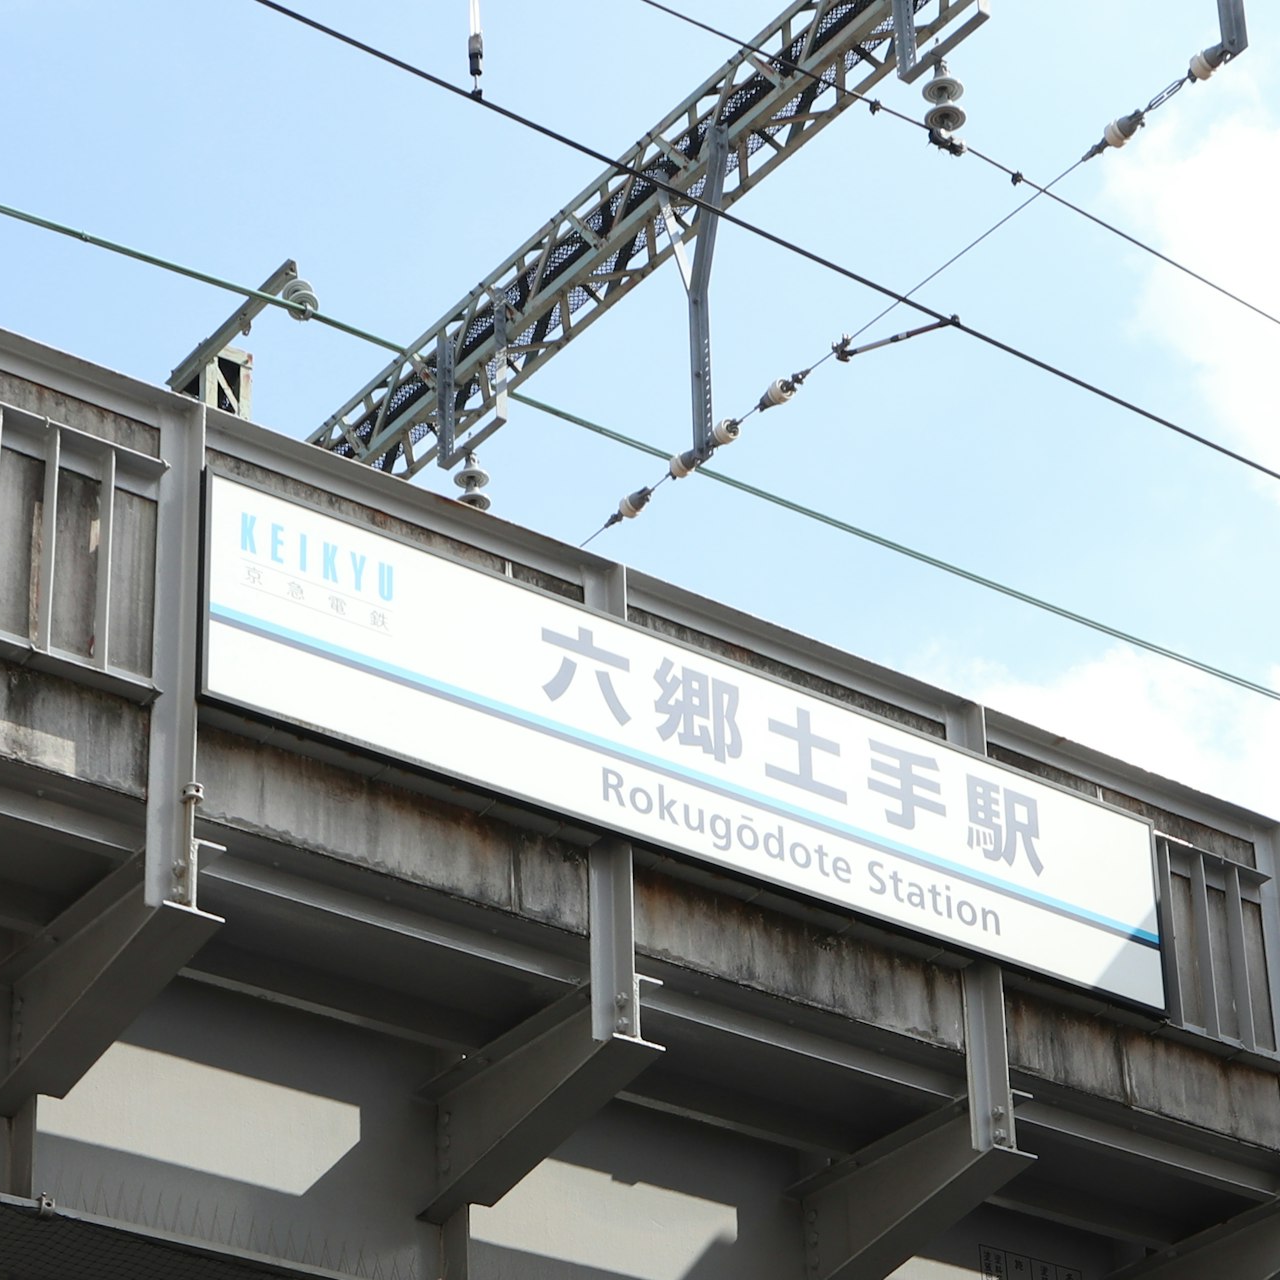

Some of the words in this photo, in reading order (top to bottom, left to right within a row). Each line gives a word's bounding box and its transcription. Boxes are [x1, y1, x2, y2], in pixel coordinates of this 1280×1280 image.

[240, 511, 394, 603] KEIKYU
[245, 566, 390, 630] 京急電鉄
[540, 626, 1044, 876] 六郷土手駅
[601, 766, 854, 884] Rokugōdote
[867, 859, 1003, 936] Station
